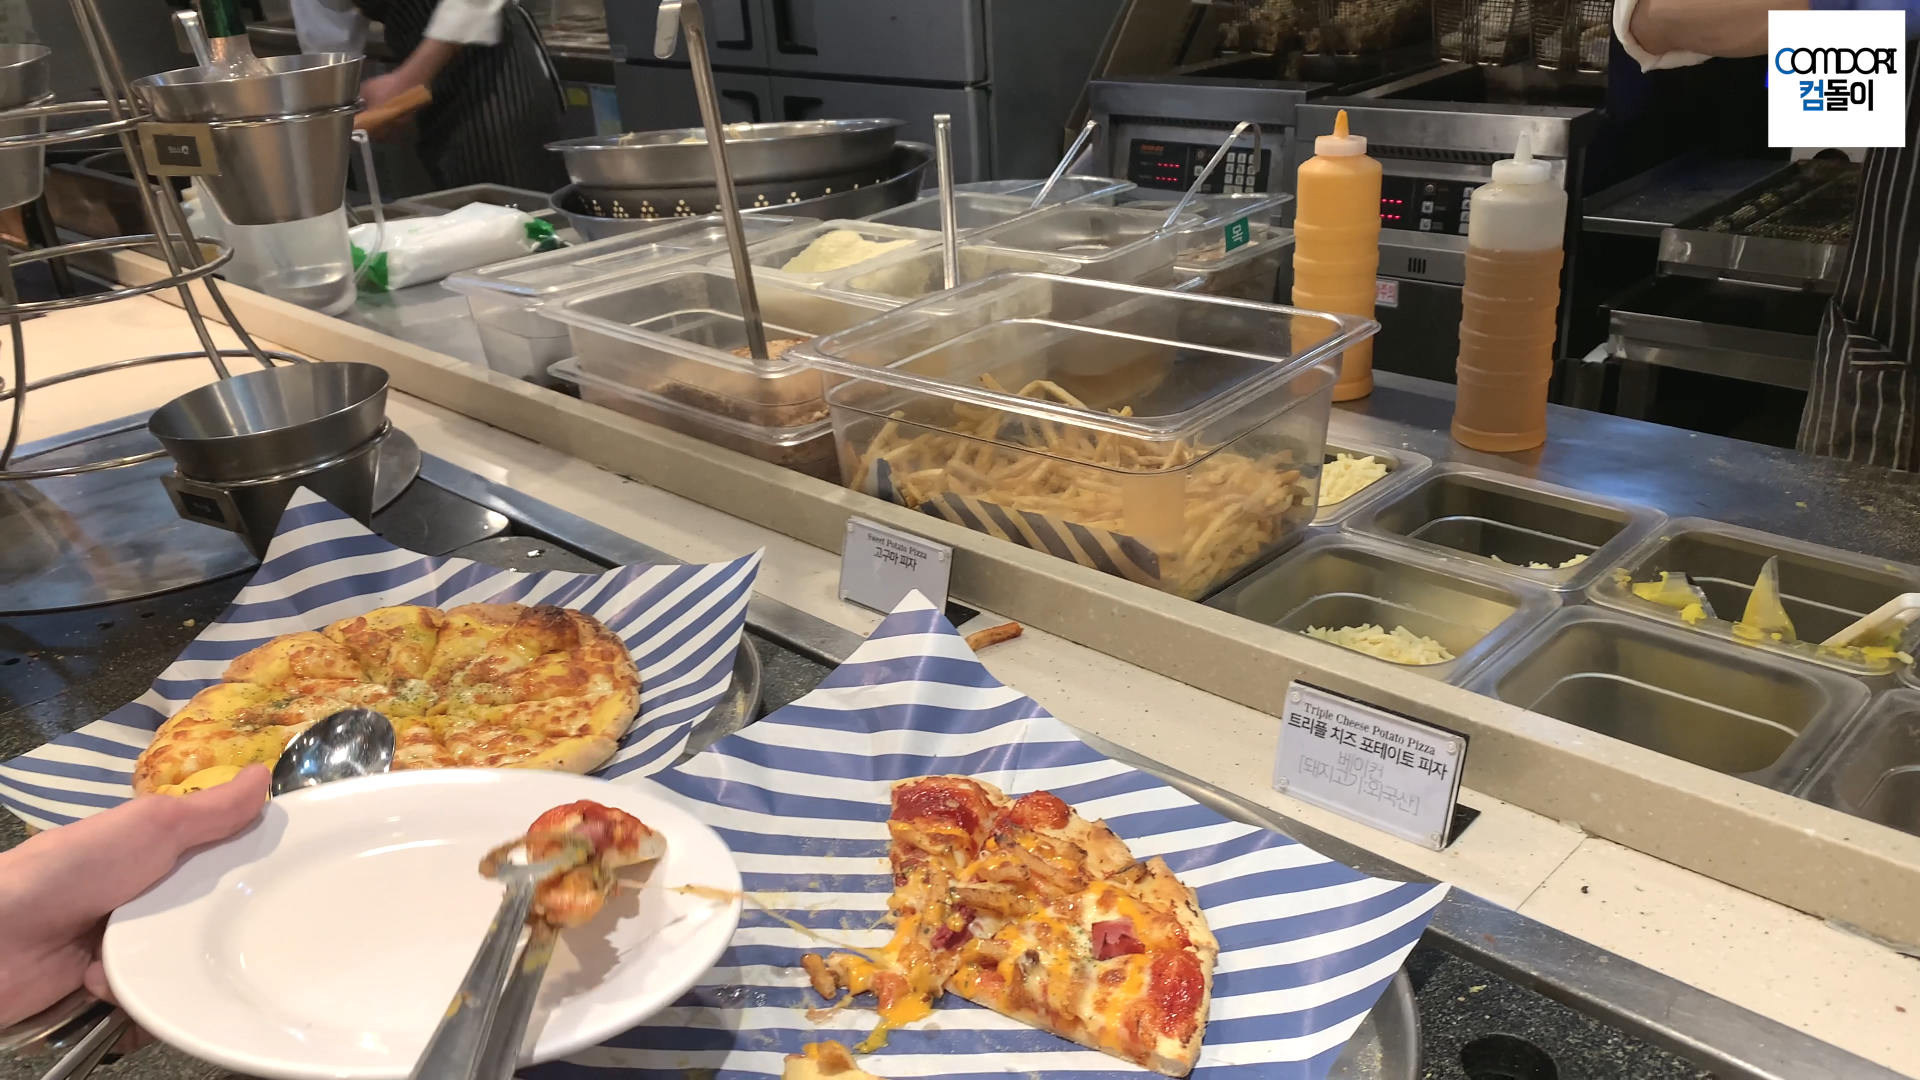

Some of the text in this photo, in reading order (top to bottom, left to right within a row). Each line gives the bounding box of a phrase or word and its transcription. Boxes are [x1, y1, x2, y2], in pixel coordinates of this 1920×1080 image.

[873, 546, 918, 572] 고구마 피자
[887, 538, 908, 553] Potato
[909, 545, 928, 560] Pizza
[1304, 702, 1436, 756] Triple Cheese Potato Pizza
[1287, 711, 1448, 781] 트리플 치즈 포테이토 피자
[1337, 750, 1384, 780] 베이컨
